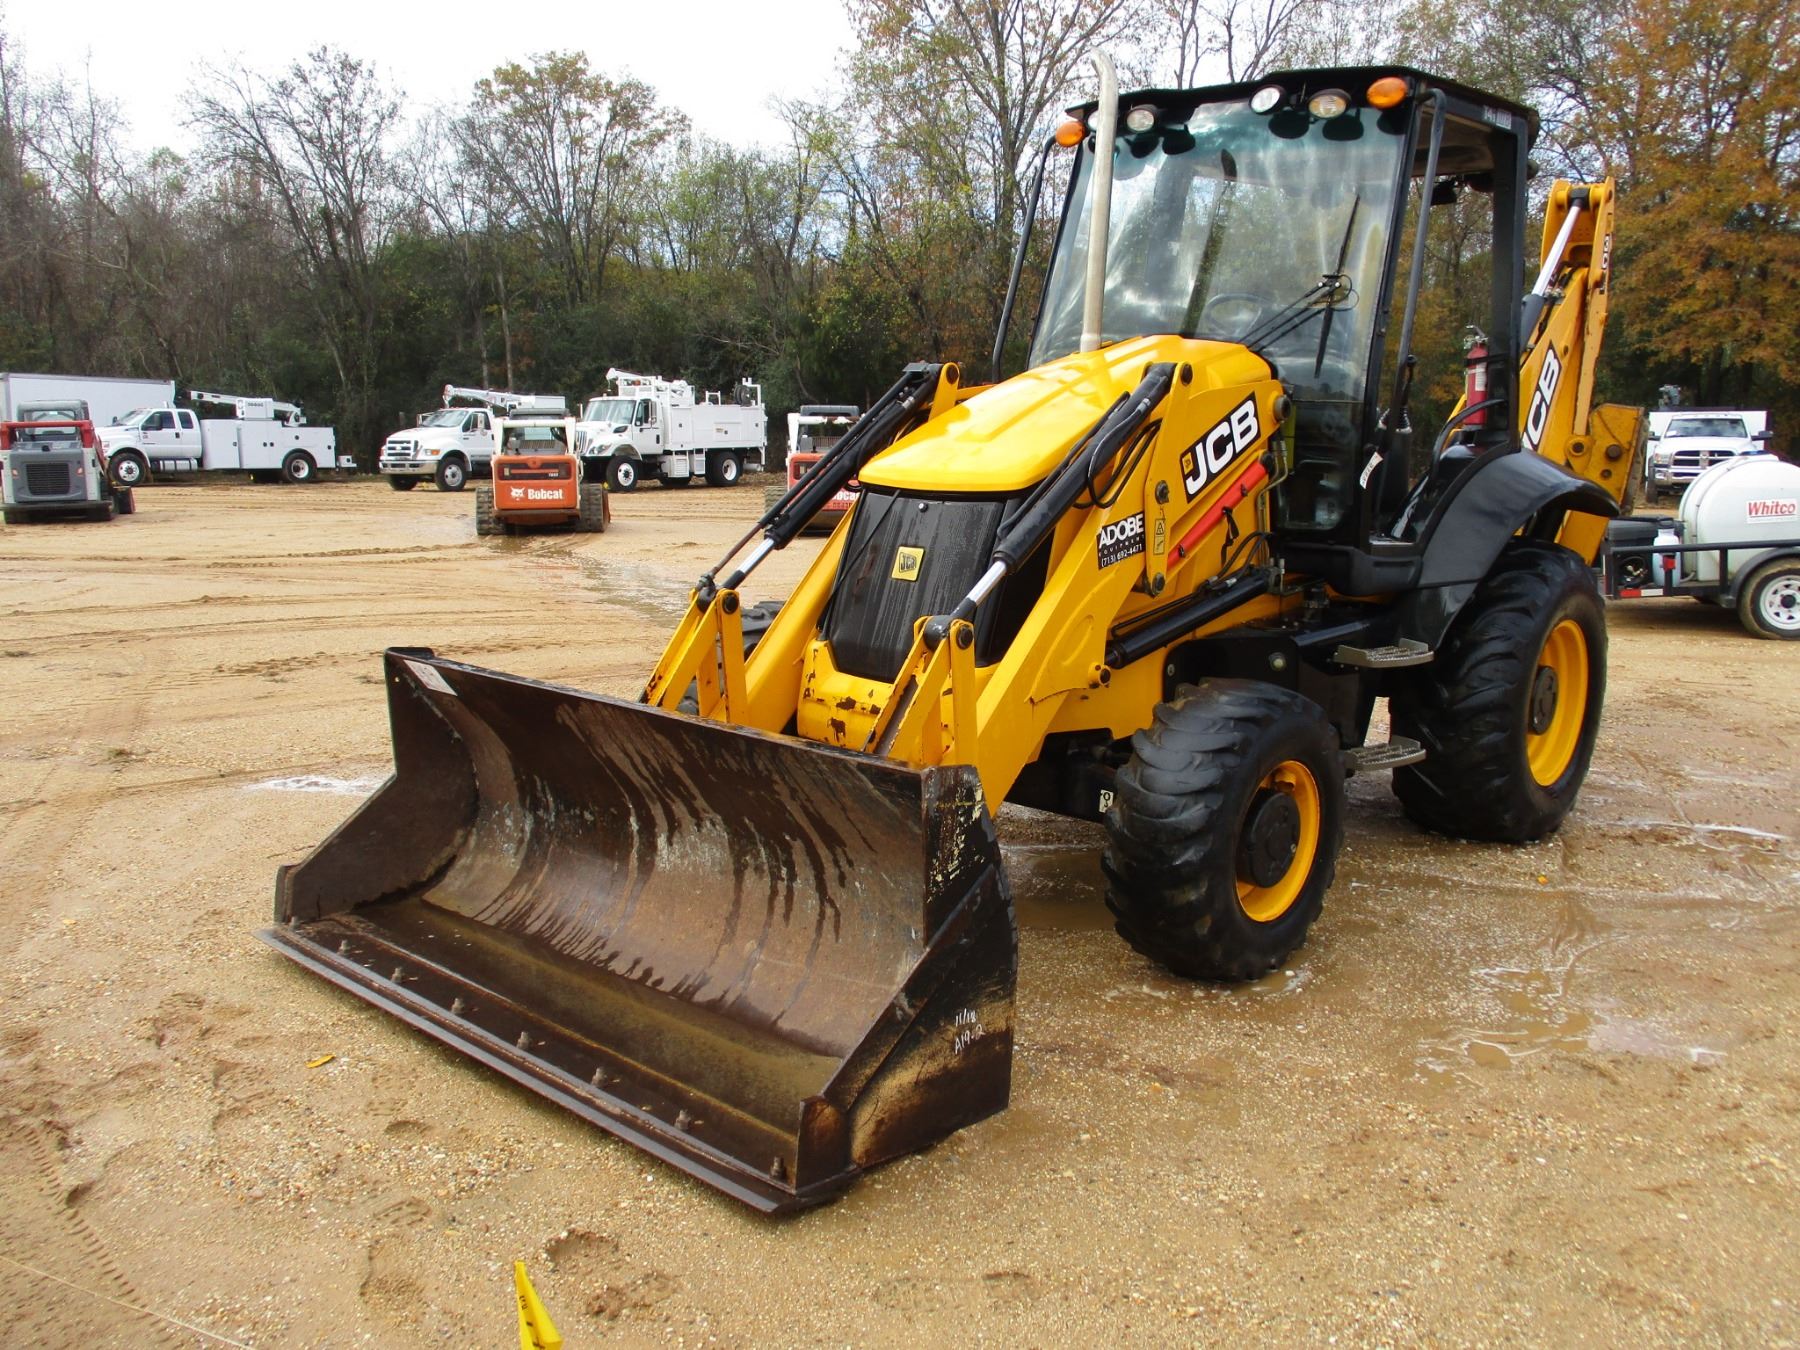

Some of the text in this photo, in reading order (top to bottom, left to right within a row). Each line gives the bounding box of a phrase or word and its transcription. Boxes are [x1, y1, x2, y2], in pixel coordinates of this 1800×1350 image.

[1522, 348, 1560, 450] CB
[1185, 400, 1258, 495] JCB
[527, 488, 563, 500] Bobcat
[1748, 500, 1796, 516] Whitco
[1098, 513, 1144, 549] ADOBE
